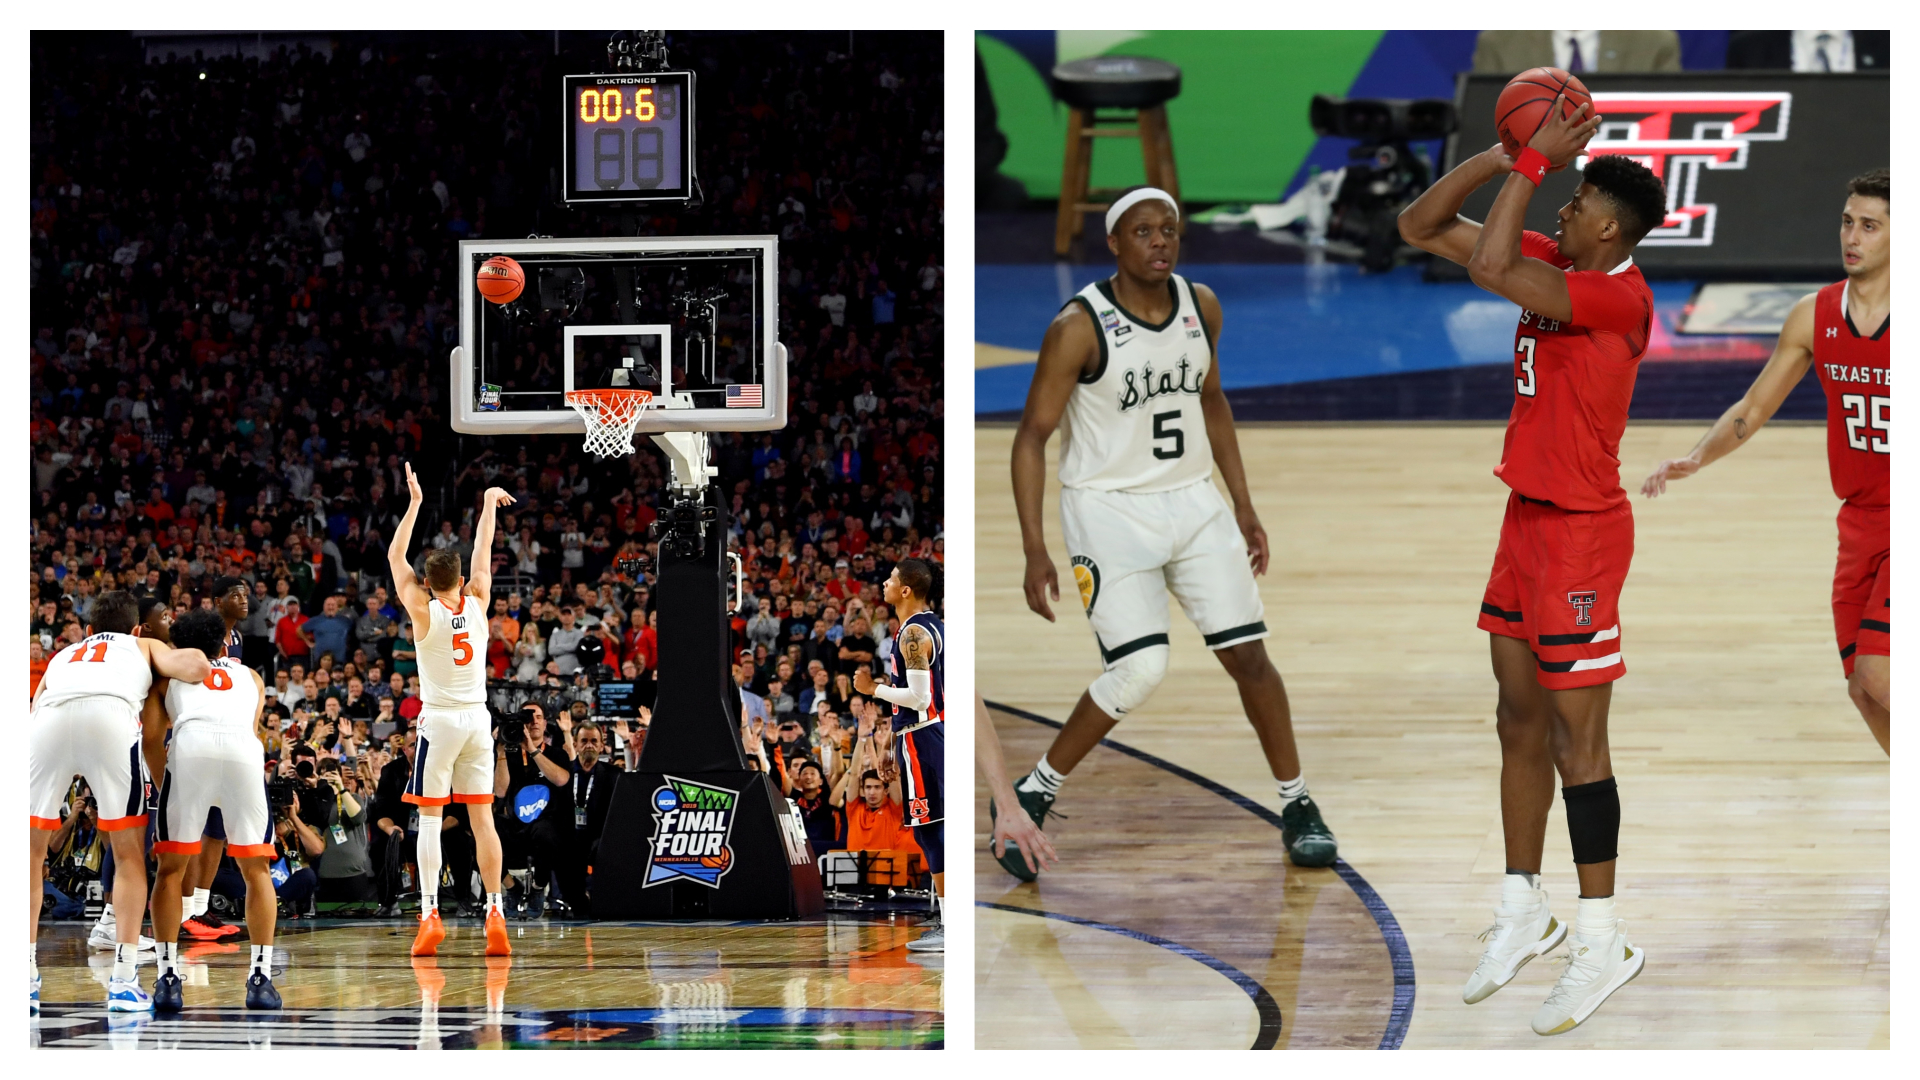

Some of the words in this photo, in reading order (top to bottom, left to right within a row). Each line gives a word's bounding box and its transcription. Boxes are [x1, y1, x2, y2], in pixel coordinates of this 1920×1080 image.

[596, 77, 657, 85] DAKTRONICS
[479, 265, 508, 278] Wils
[1516, 336, 1536, 397] 3
[1824, 363, 1870, 383] TEXAS
[1153, 409, 1184, 460] 5
[1842, 393, 1890, 454] 25
[451, 616, 466, 630] GUY
[68, 641, 108, 663] 11
[452, 632, 474, 666] 5
[660, 808, 727, 833] FINAL
[655, 832, 724, 856] FOUR
